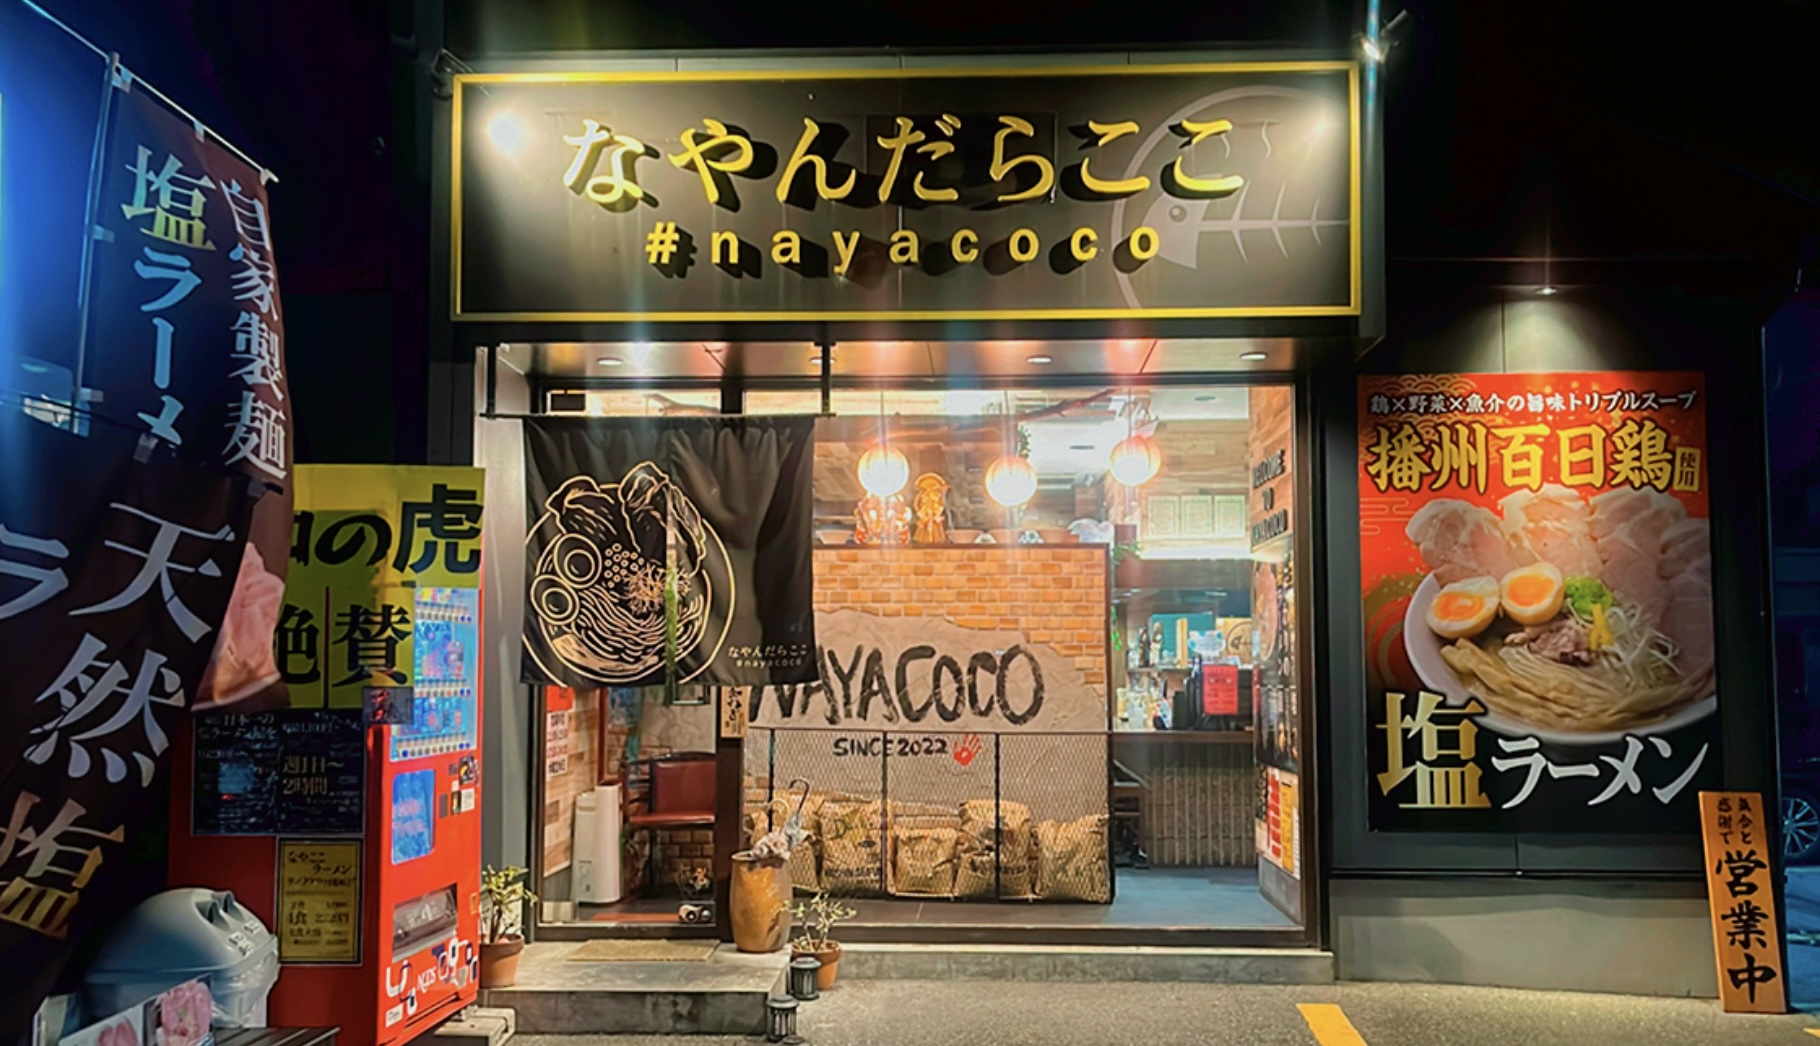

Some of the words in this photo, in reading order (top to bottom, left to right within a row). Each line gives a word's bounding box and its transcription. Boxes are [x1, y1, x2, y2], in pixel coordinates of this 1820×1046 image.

[562, 114, 1245, 204] なやんだらここ
[645, 220, 1162, 276] #nayacoco
[121, 145, 216, 456] 塩ラーメ
[220, 179, 288, 480] 自家製麺
[1367, 418, 1673, 493] 播州百日鶏
[291, 484, 482, 574] の虎
[728, 643, 808, 658] なやんだらここ
[0, 502, 235, 940] 天然塩
[833, 737, 893, 758] SINCE
[897, 737, 948, 756] 2022
[1376, 691, 1709, 809] 塩ラーメン
[1716, 848, 1778, 1004] 営業中
